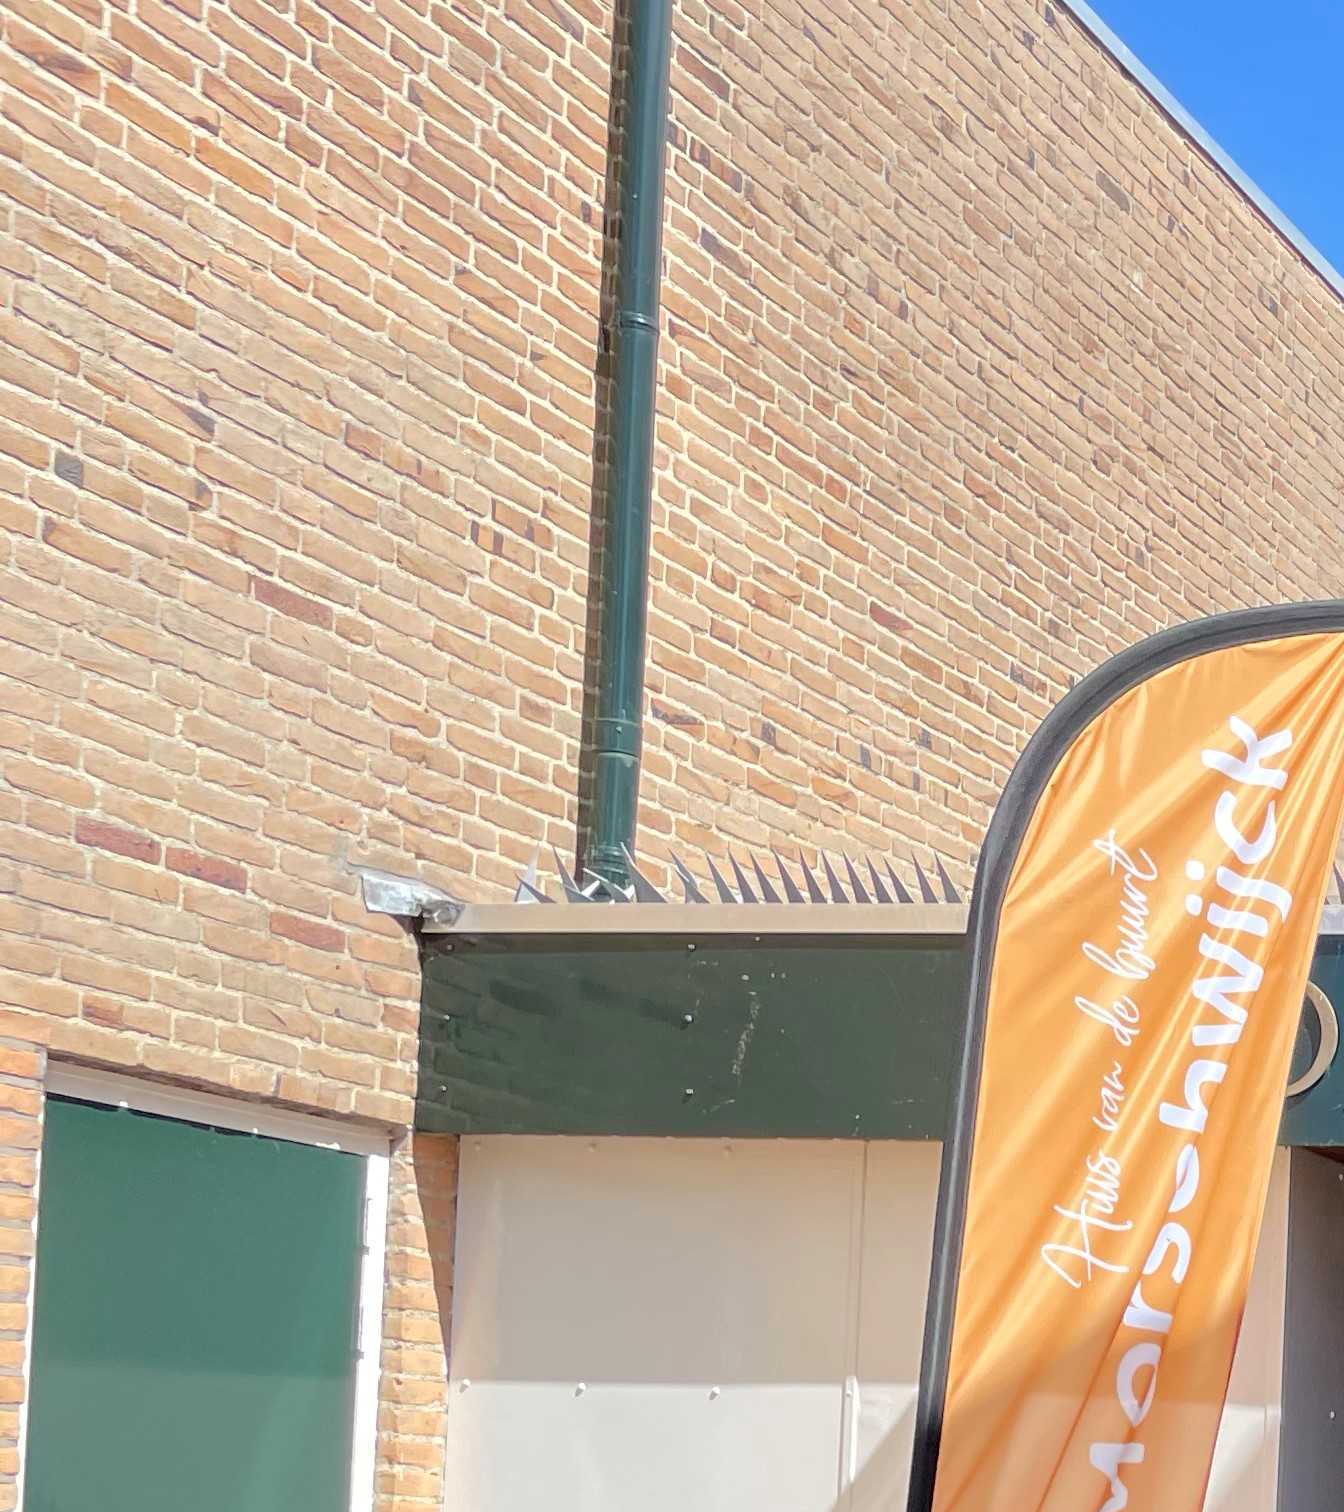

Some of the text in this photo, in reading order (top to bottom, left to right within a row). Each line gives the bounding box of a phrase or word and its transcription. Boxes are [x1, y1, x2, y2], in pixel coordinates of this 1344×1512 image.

[1040, 828, 1159, 1289] Huis van de buurt
